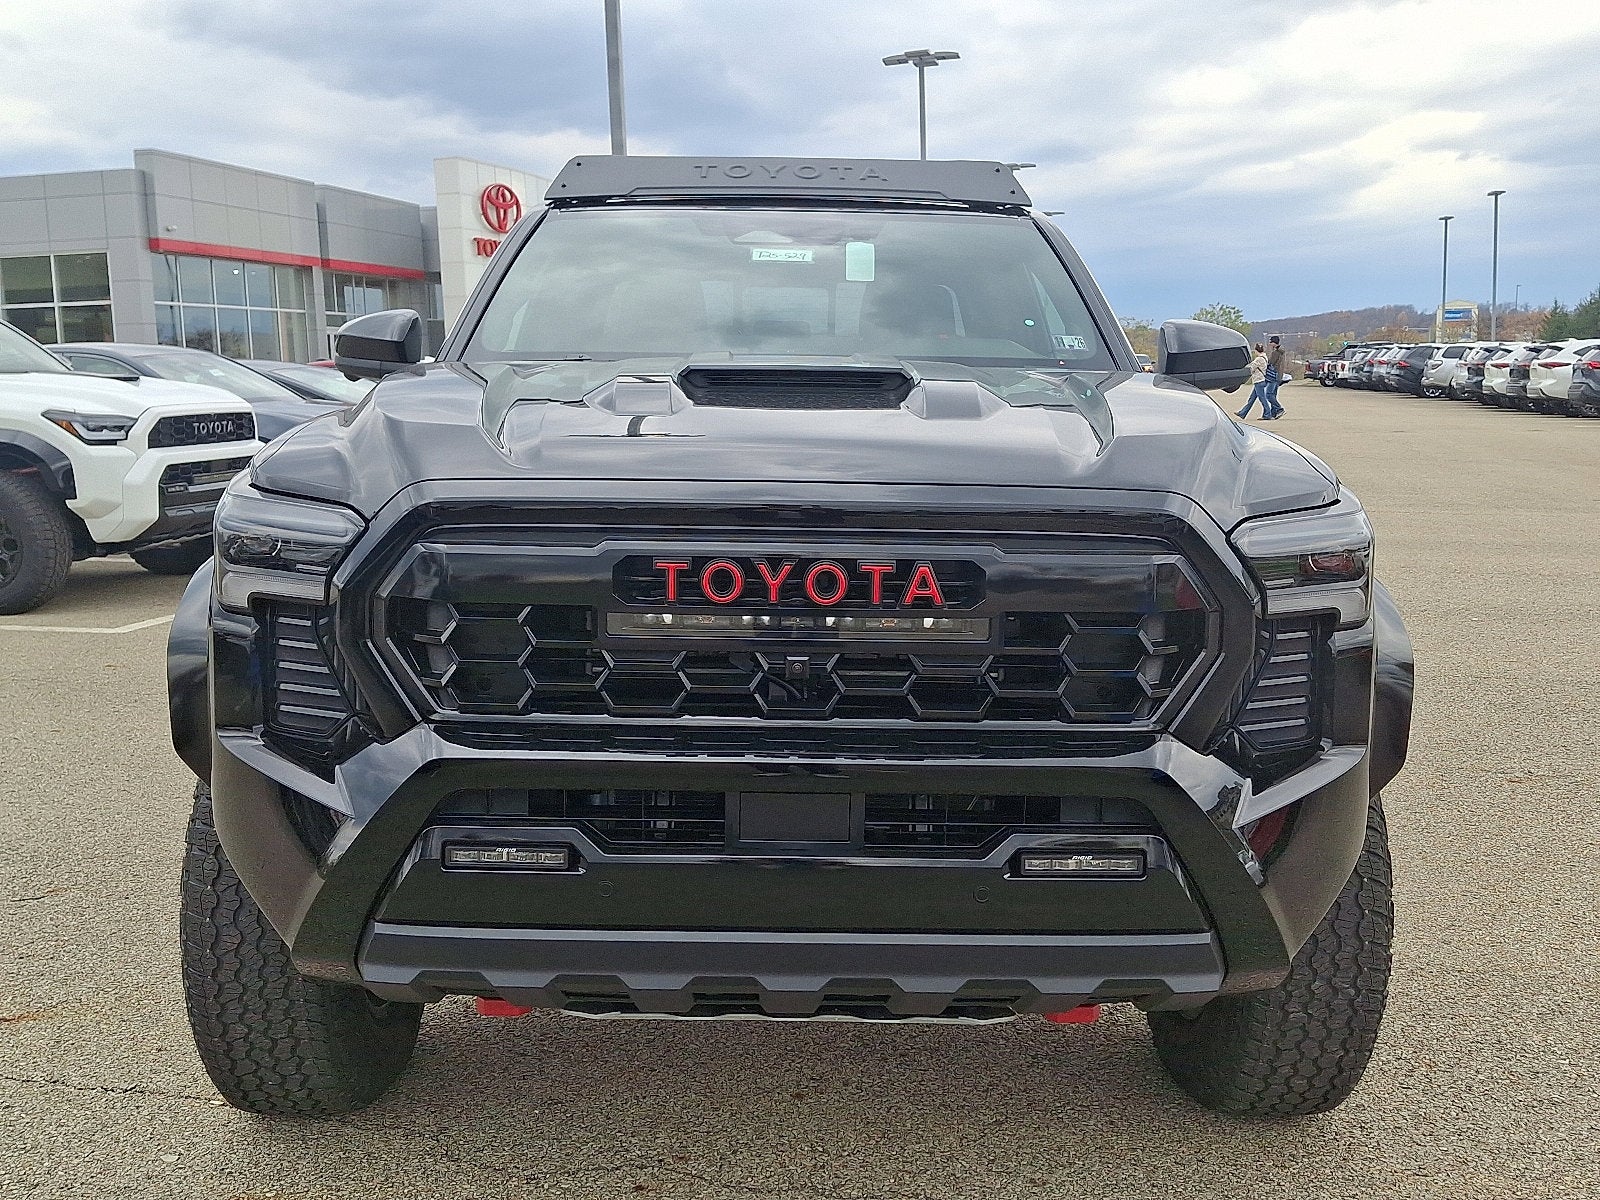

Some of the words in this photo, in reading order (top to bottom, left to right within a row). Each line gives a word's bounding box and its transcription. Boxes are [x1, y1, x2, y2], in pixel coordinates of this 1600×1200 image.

[693, 165, 889, 182] TOYOTA
[192, 420, 234, 435] TOYOTA
[652, 557, 947, 608] TOYOTA
